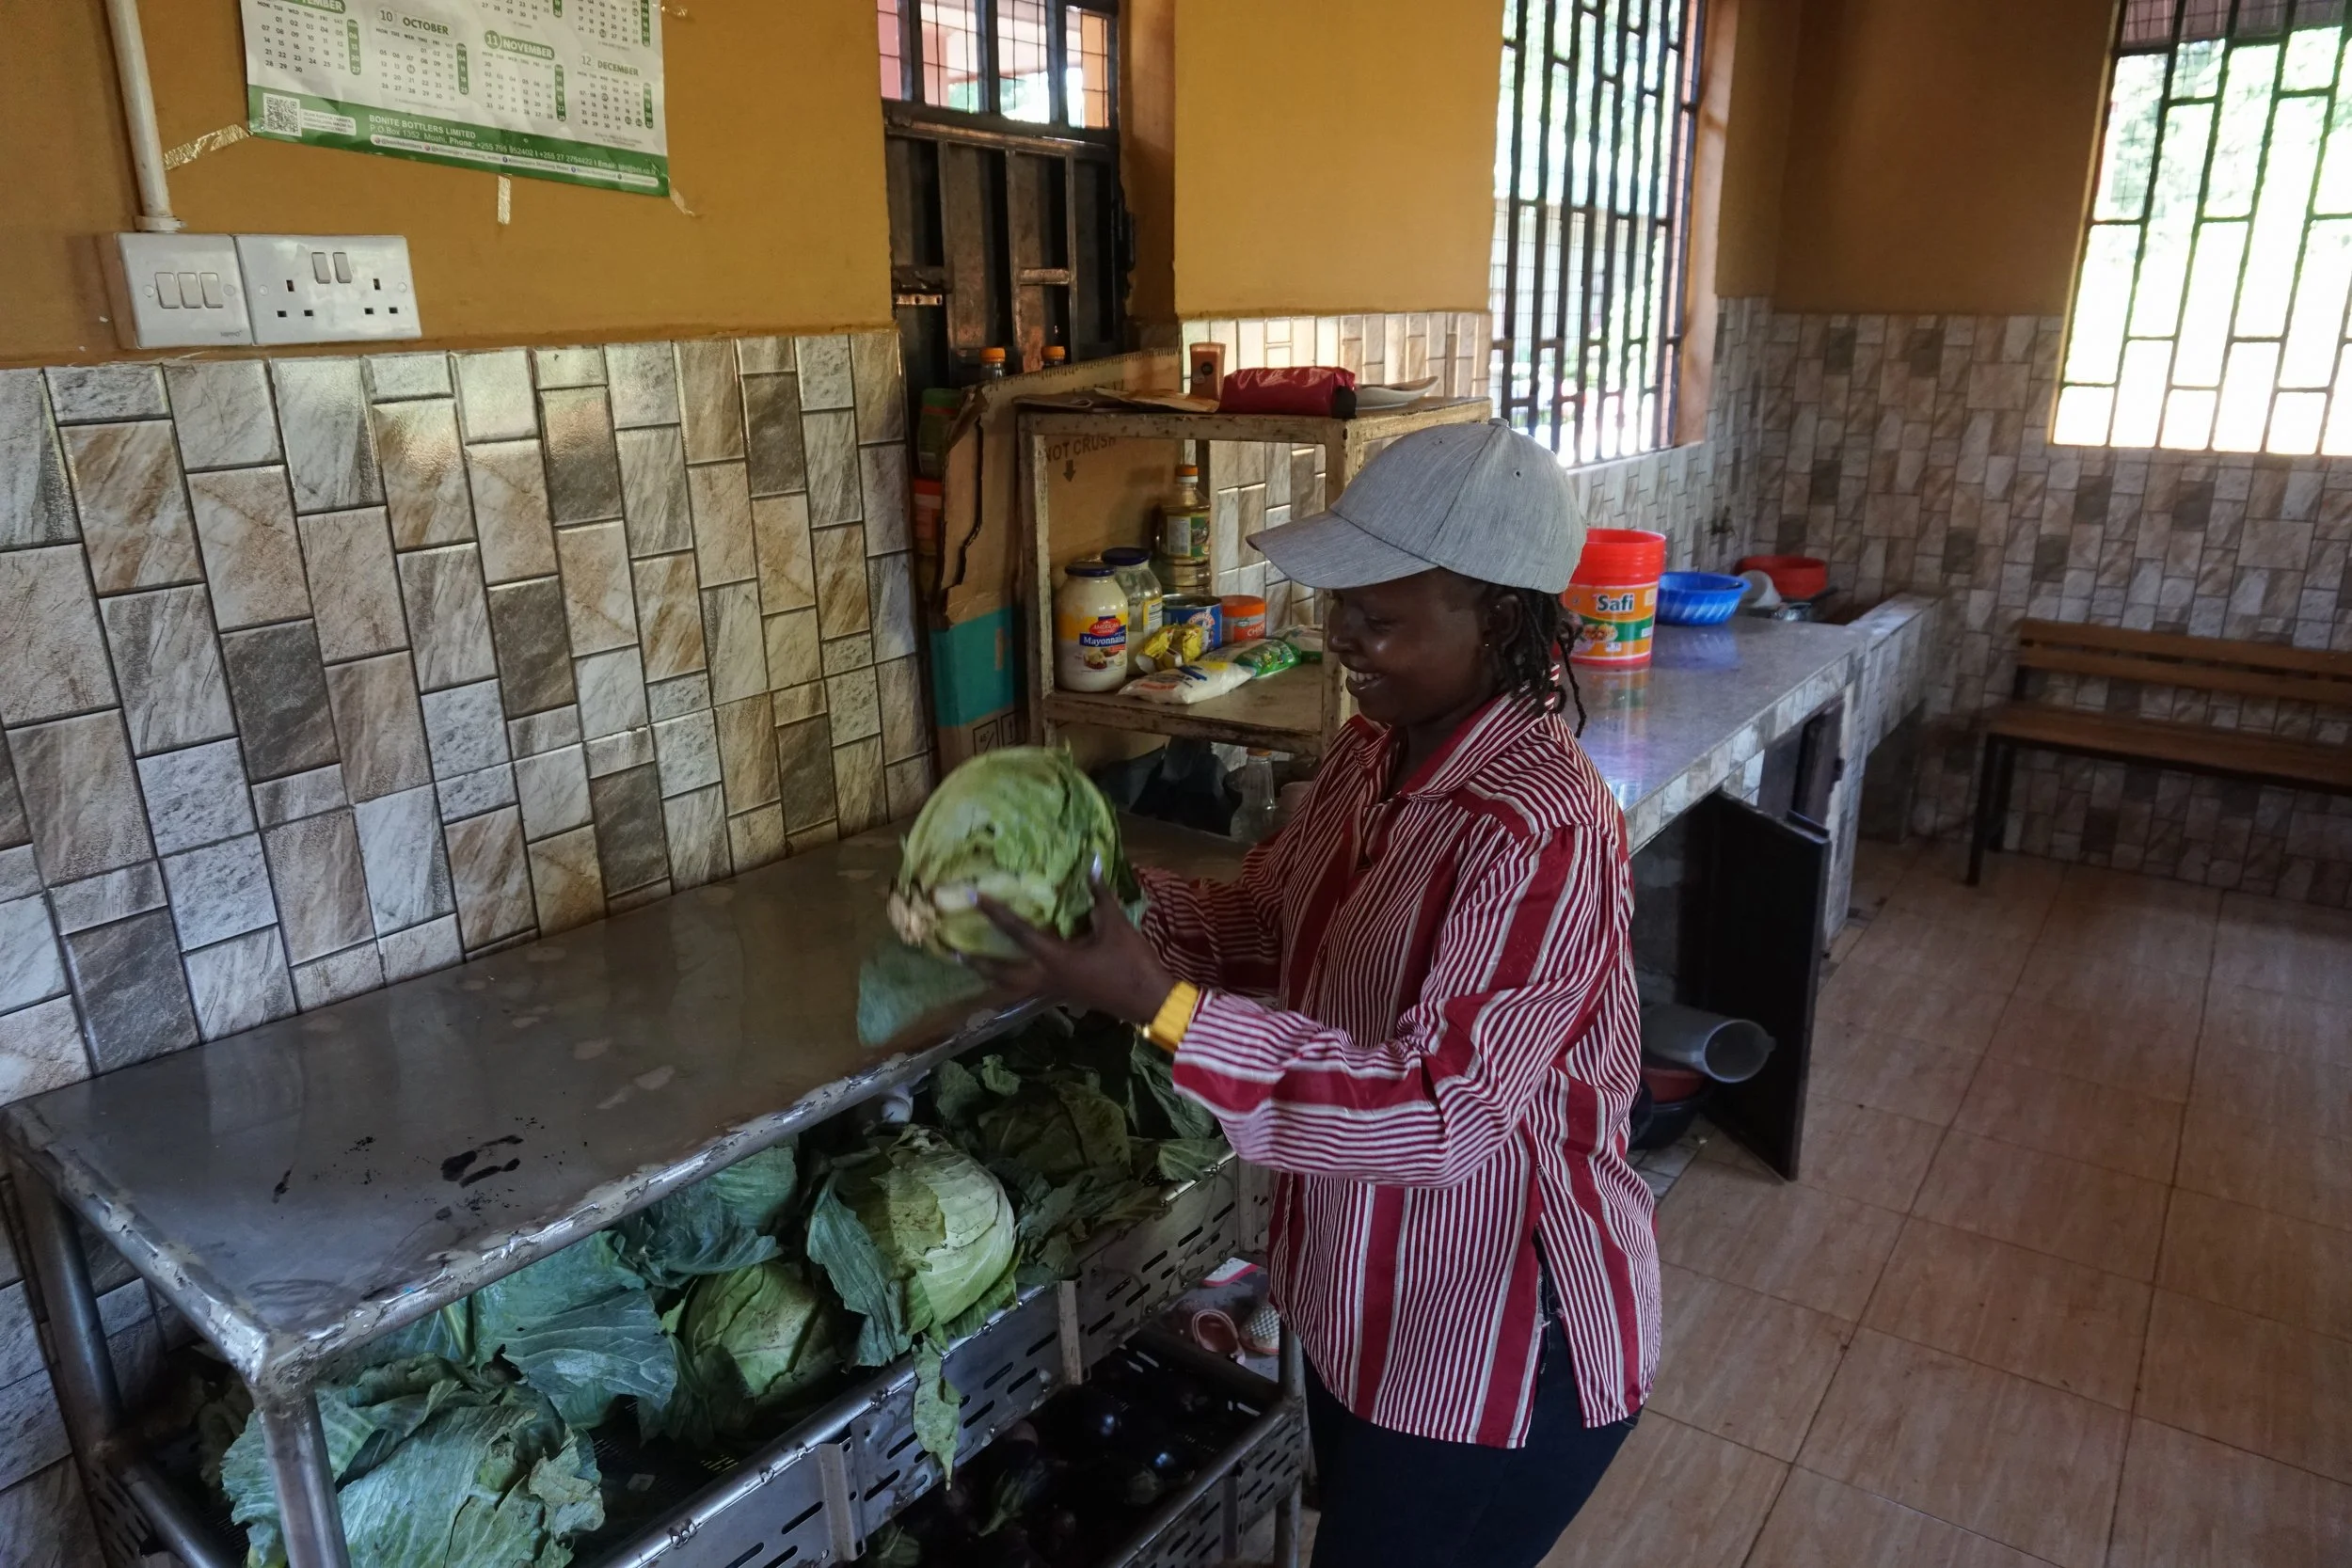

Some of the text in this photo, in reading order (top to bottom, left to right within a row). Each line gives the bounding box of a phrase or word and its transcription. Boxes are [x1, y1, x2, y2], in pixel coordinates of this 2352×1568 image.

[290, 19, 298, 27] 02
[379, 9, 450, 36] 10 OCTOBER
[486, 34, 553, 58] 11 NOVEMBER
[581, 55, 639, 77] 12 DECEMBER
[369, 114, 400, 127] BONITE
[401, 120, 444, 135] BOTTLERS
[445, 127, 476, 139] LIMITED
[449, 136, 475, 148] Phone:
[477, 141, 494, 150] +255
[539, 150, 555, 160] +255
[597, 159, 617, 169] Email:
[1045, 435, 1117, 463] NOT CRUSH
[1597, 594, 1634, 611] Safi
